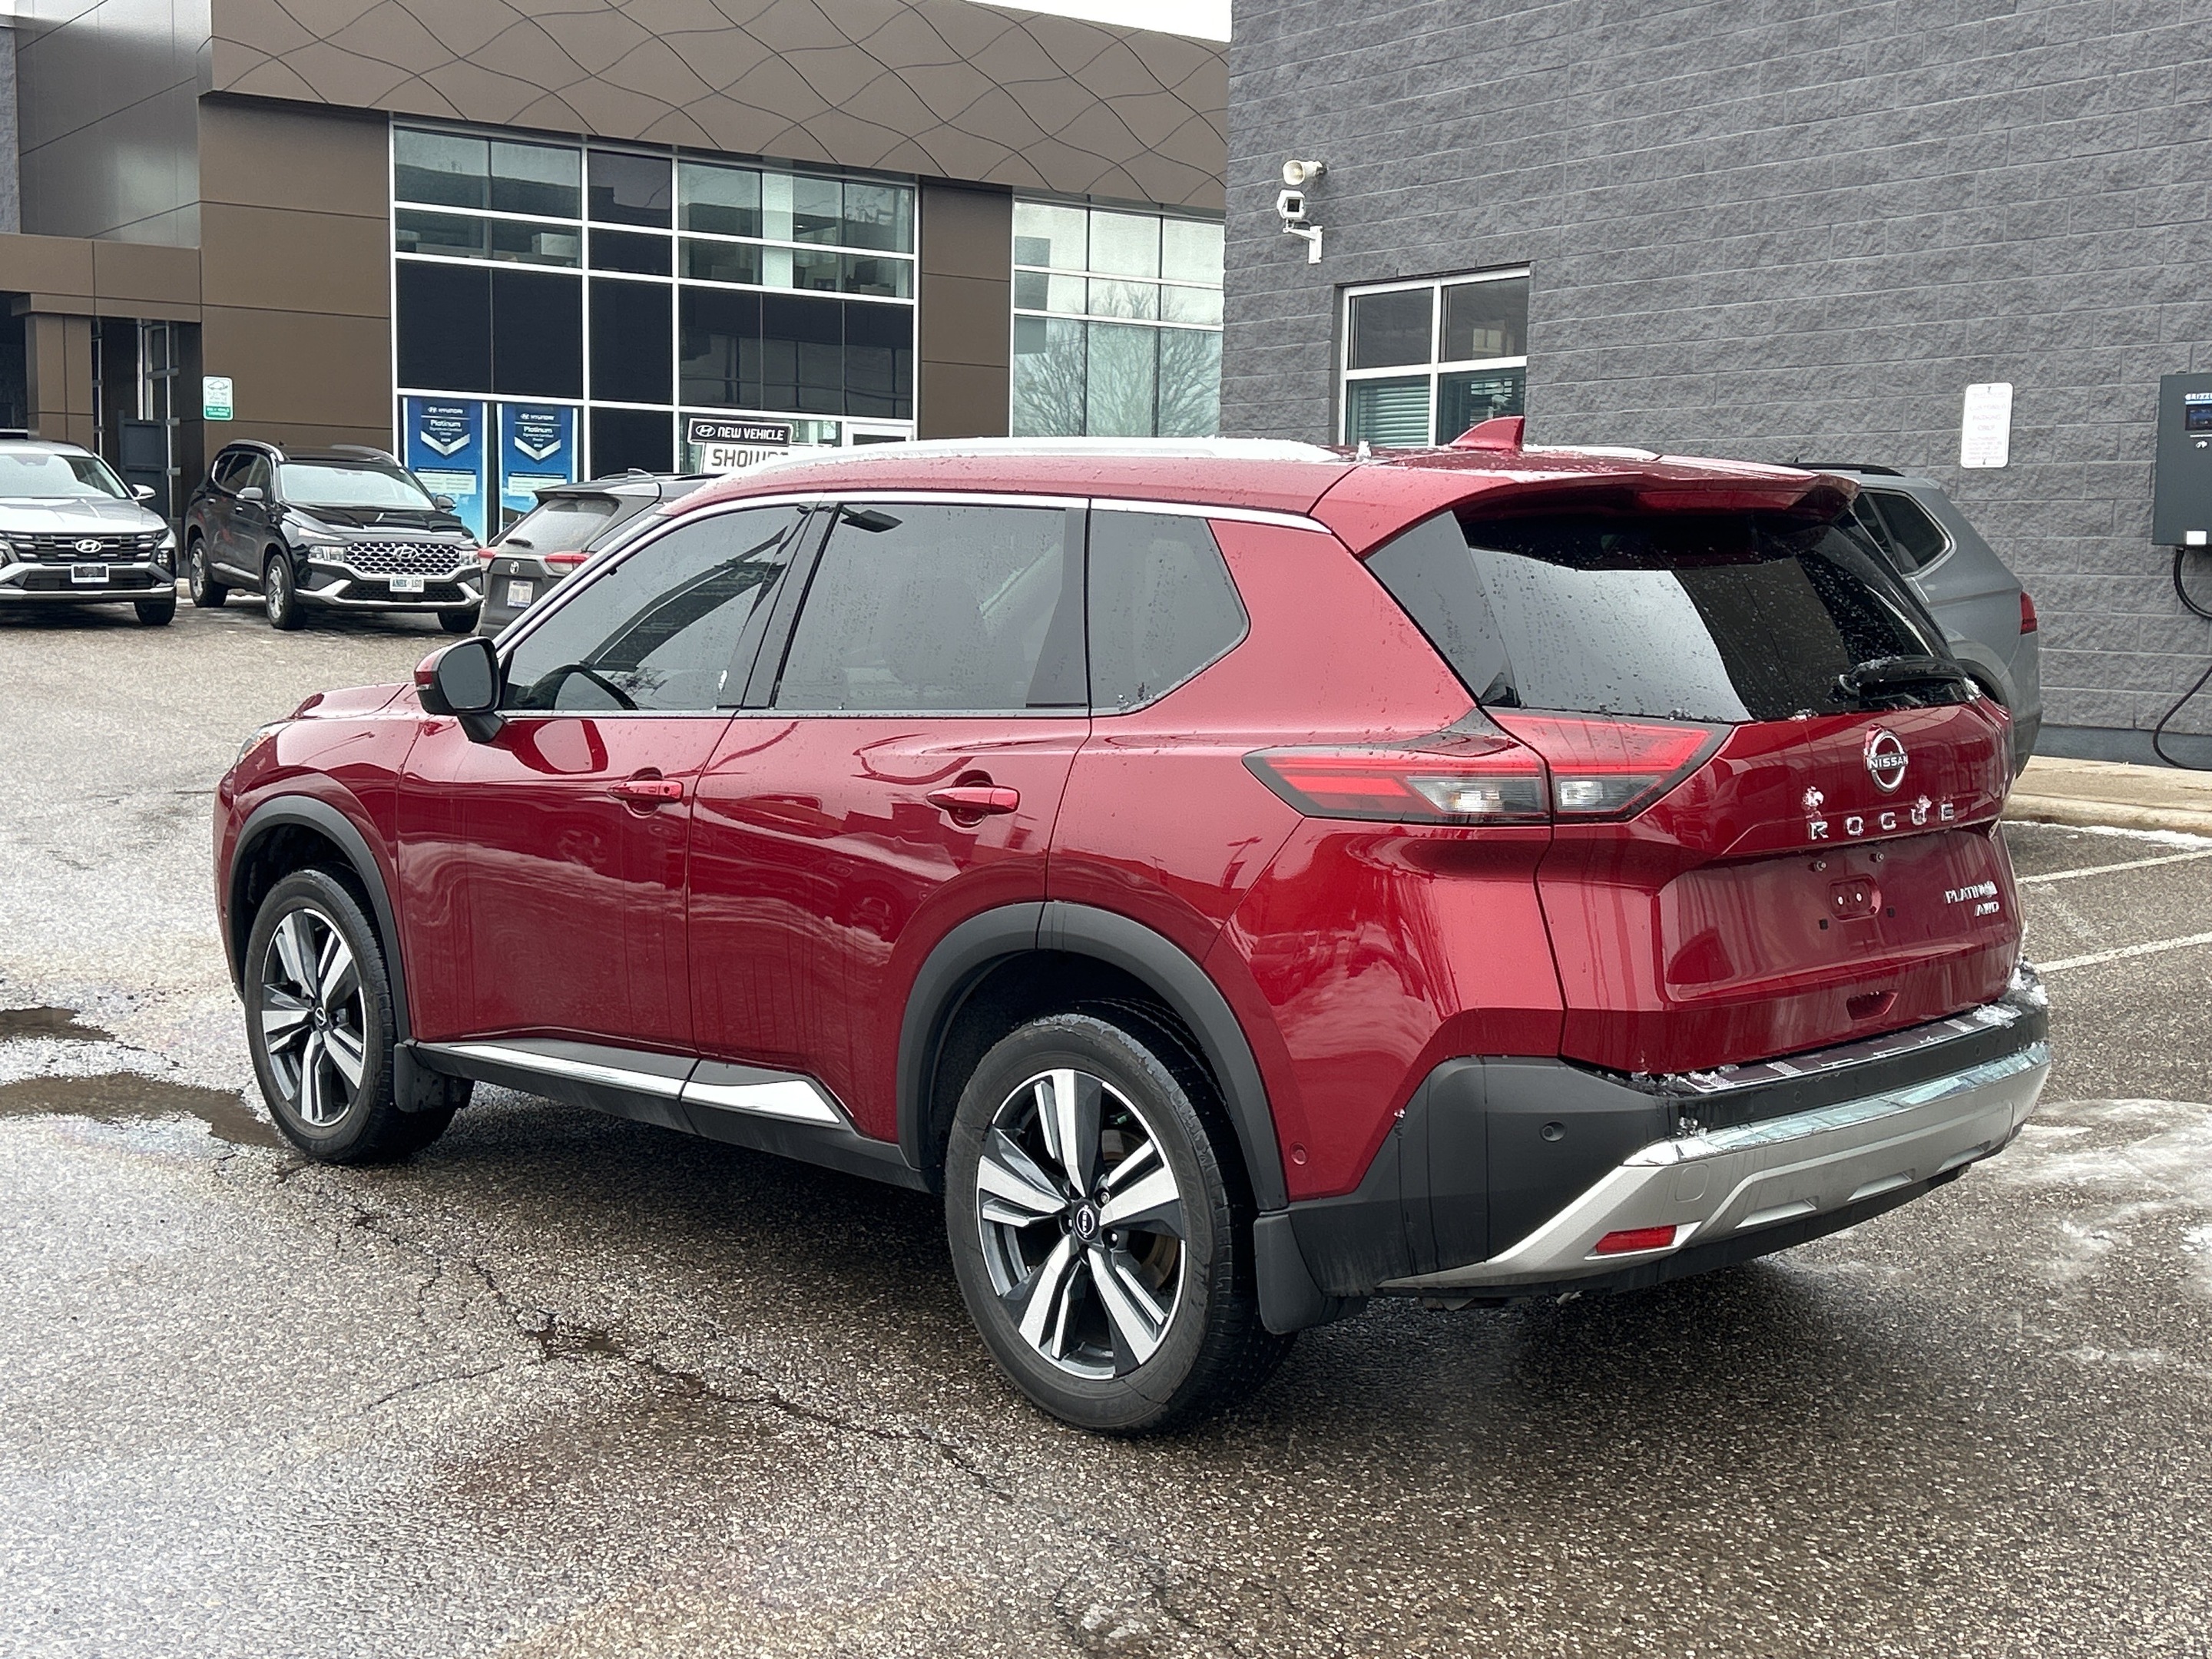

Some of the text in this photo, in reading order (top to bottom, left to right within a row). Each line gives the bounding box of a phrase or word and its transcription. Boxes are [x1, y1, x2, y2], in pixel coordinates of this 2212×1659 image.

[430, 419, 461, 428] Platinum
[717, 426, 785, 441] NEW VEHICLE
[1869, 753, 1909, 770] NISSAN
[1810, 803, 1955, 839] ROGUE
[1945, 880, 1998, 904] PLATIN
[1974, 901, 2000, 916] AWD
